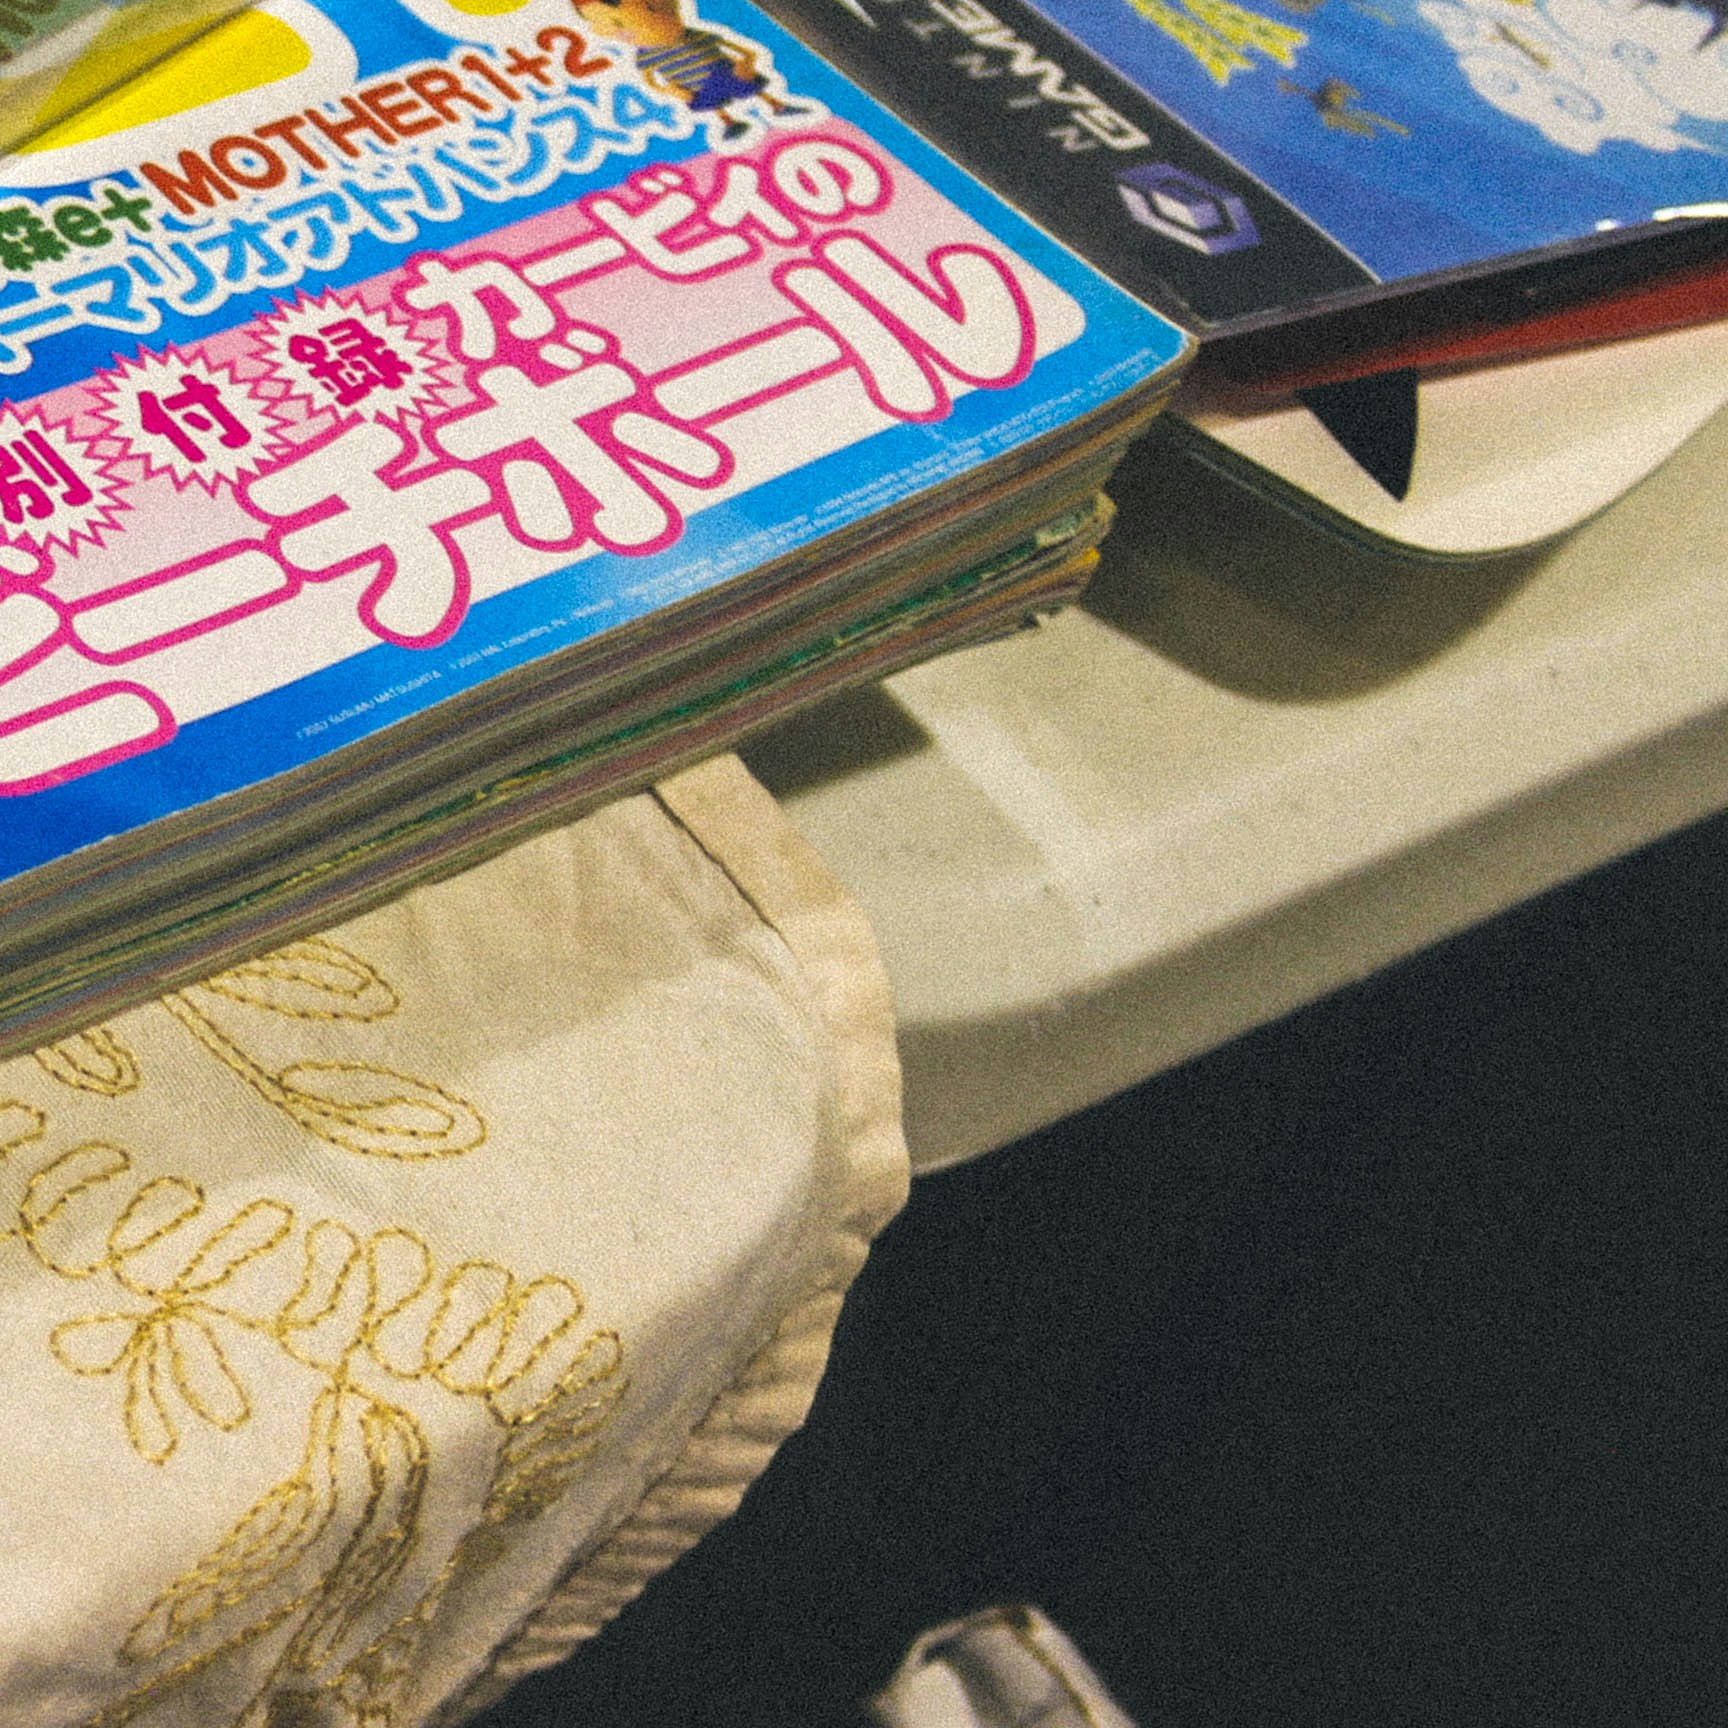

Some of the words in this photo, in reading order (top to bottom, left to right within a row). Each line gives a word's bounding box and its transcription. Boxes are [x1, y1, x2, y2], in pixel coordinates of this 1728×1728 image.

[406, 136, 887, 362] カービィの
